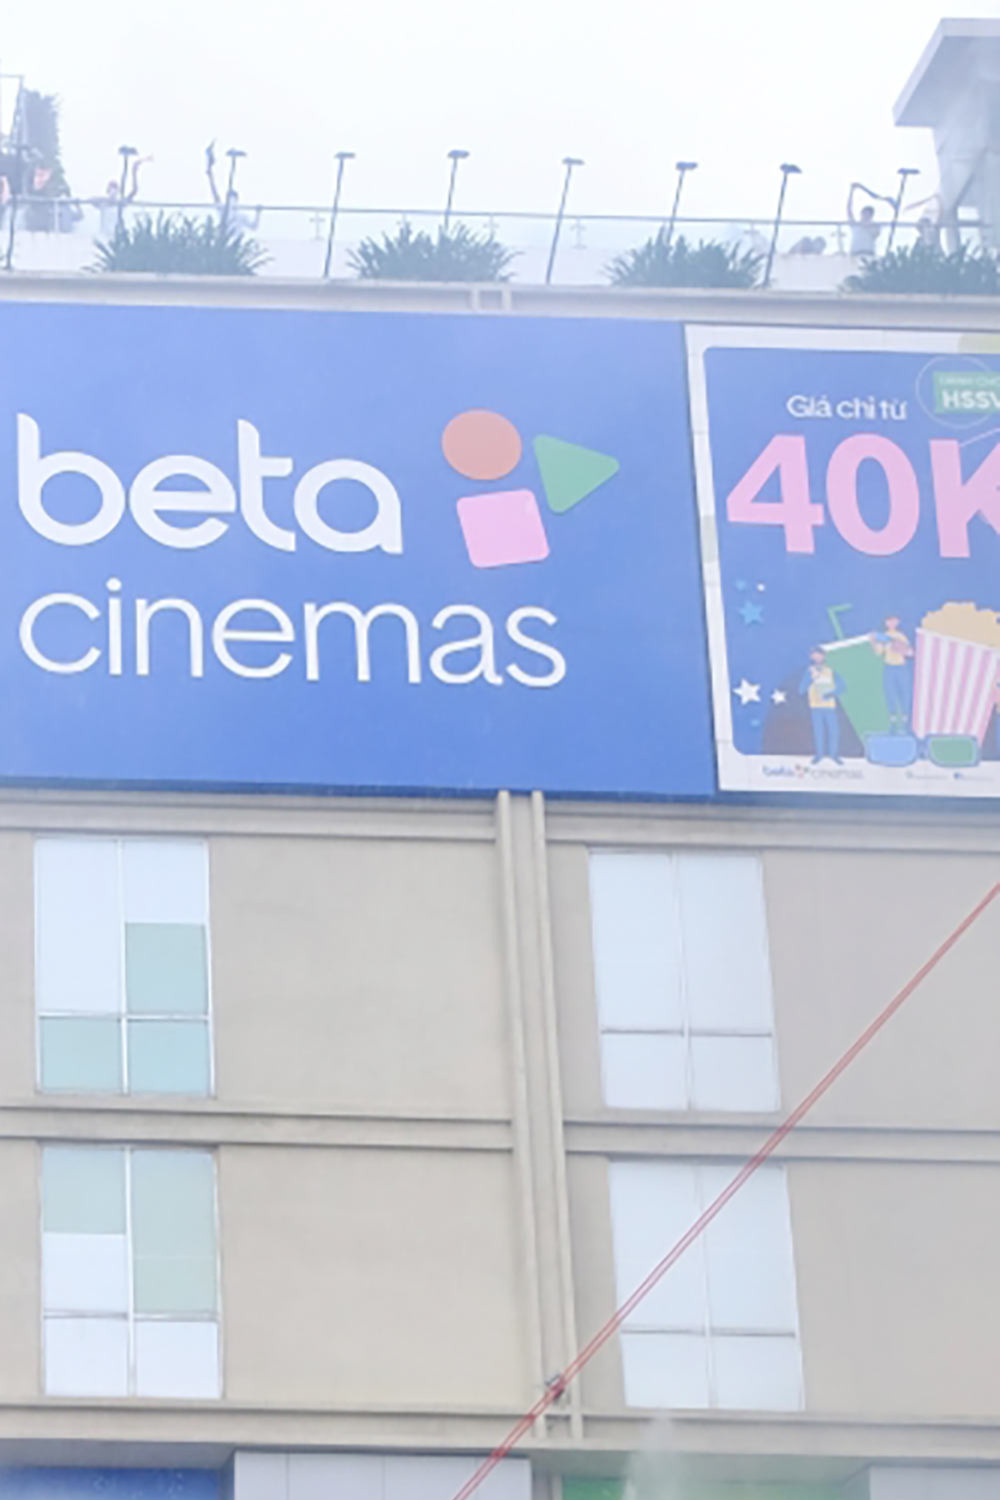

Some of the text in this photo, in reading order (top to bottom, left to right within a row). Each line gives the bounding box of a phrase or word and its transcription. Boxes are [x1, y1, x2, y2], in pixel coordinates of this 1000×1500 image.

[786, 394, 832, 418] Giá
[17, 412, 403, 554] beta
[726, 432, 1000, 558] 40K
[18, 577, 567, 688] cinemas
